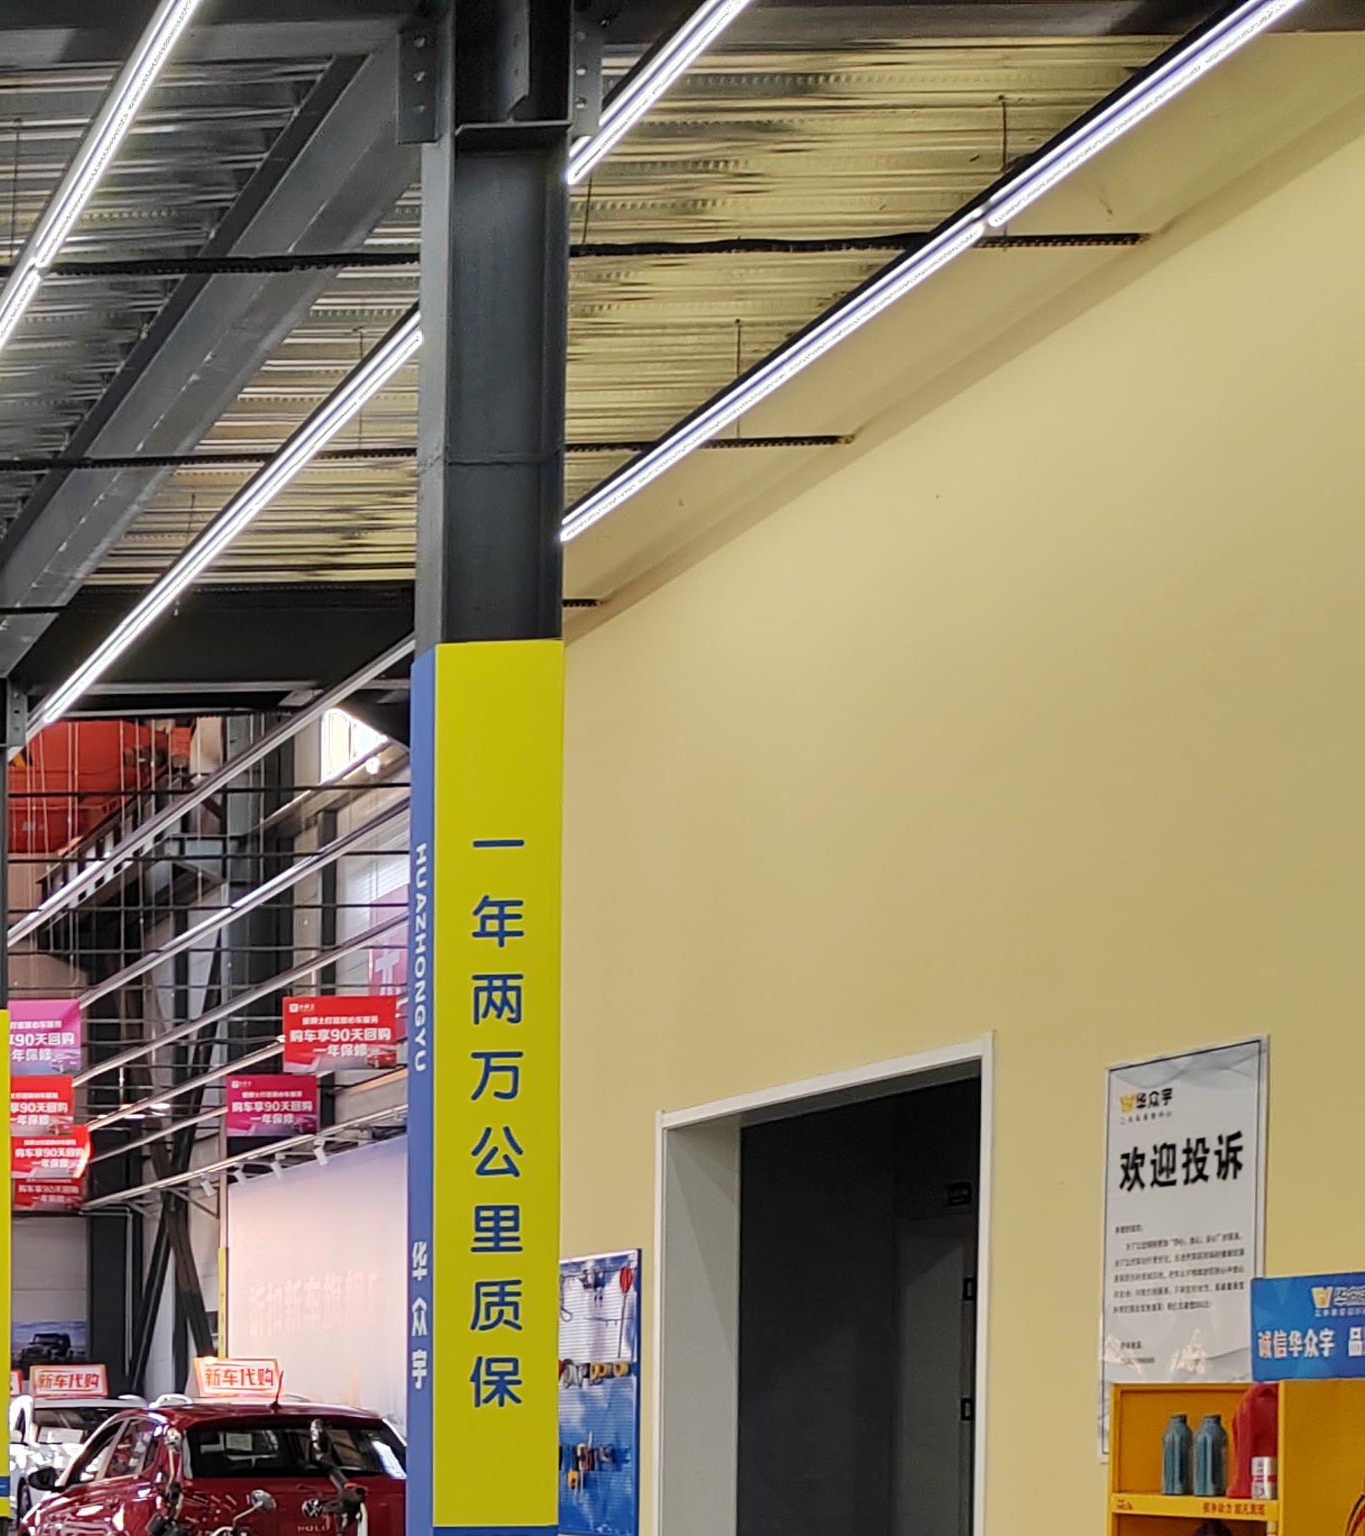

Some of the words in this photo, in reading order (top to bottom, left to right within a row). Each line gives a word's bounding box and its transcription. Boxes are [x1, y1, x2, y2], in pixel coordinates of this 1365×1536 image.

[414, 843, 427, 1071] HUAZHONGYU
[289, 1028, 391, 1042] 购车享90天回购
[313, 1044, 368, 1057] 一年保修
[232, 1101, 312, 1112] 购车享90天回购
[1136, 1088, 1173, 1109] 华众宇
[470, 837, 526, 1408] 一年两万公里质保
[1119, 1130, 1244, 1192] 欢迎投诉
[412, 1241, 428, 1389] 华众宇
[1257, 1328, 1335, 1358] 诚信华众宇
[38, 1372, 100, 1388] 新车代购
[204, 1367, 275, 1387] 新车代购
